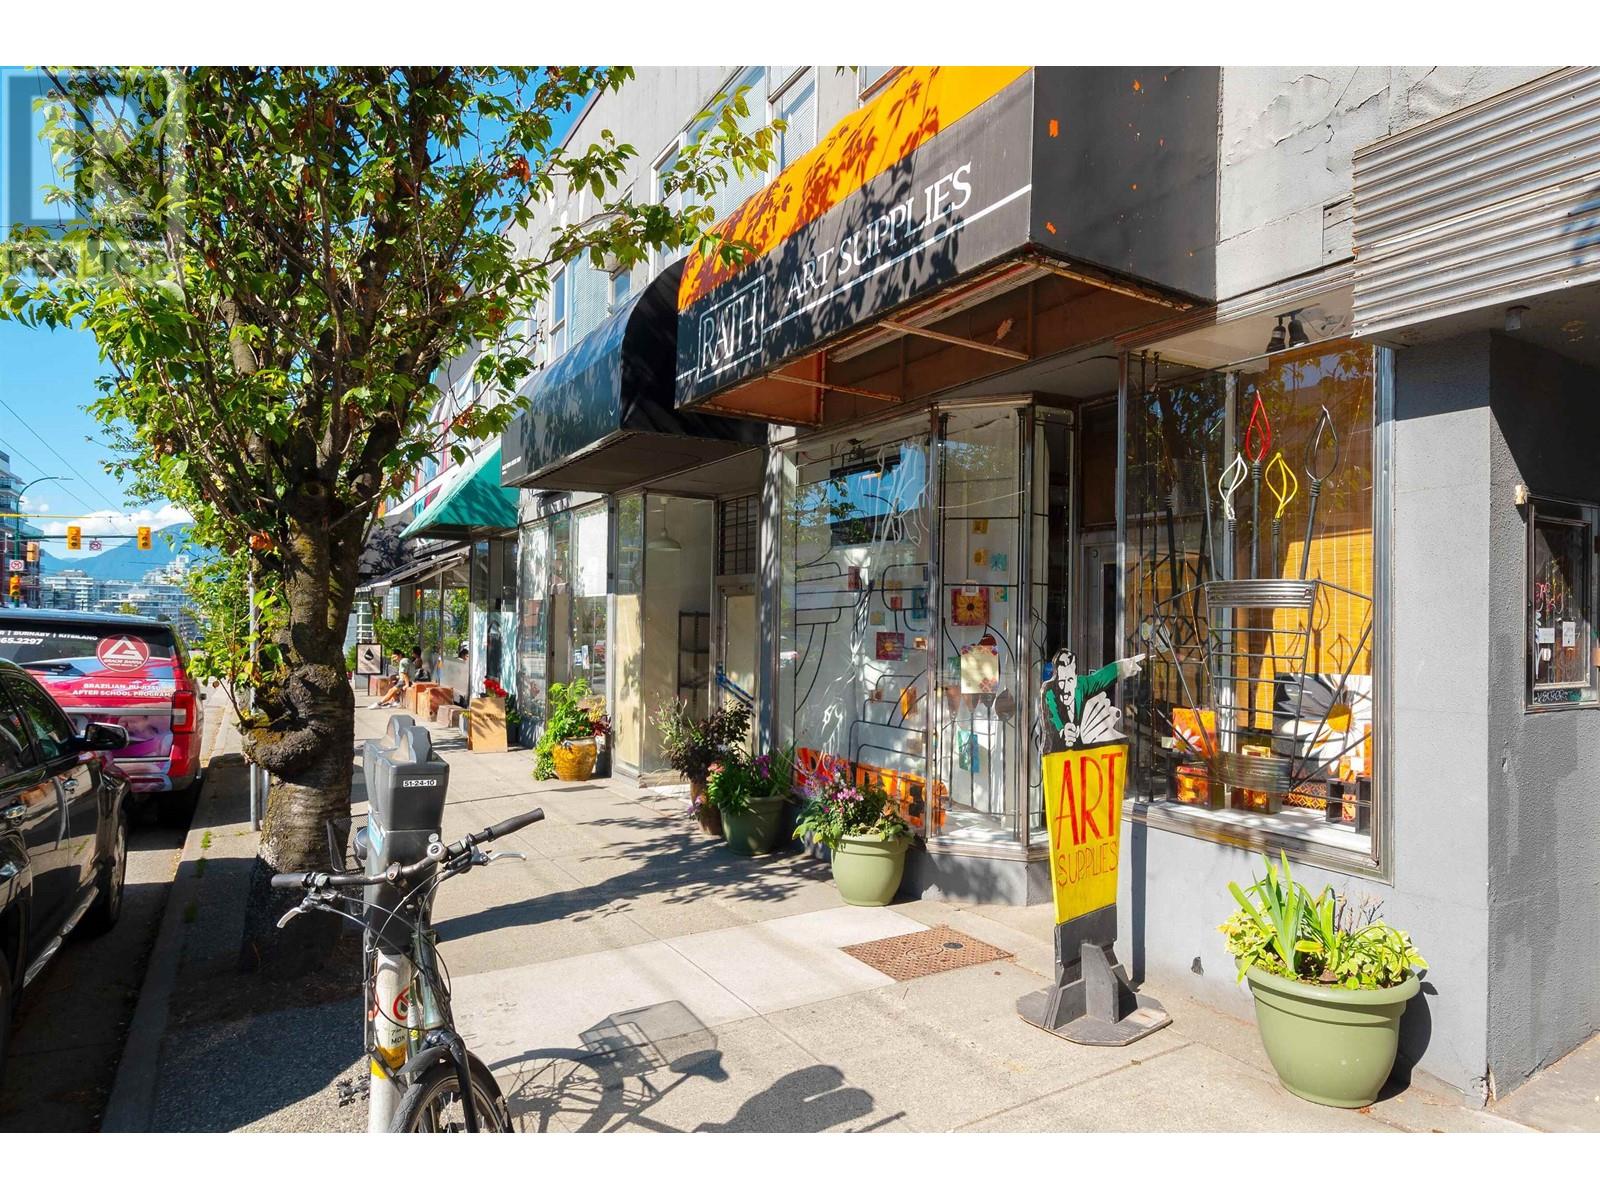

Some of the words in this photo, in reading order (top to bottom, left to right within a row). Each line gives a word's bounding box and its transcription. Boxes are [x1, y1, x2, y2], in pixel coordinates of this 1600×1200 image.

[701, 288, 759, 370] RATH
[784, 246, 834, 305] ART
[837, 161, 972, 277] SUPPLIES
[1055, 753, 1123, 850] ART
[1057, 842, 1118, 888] SUPPLIES
